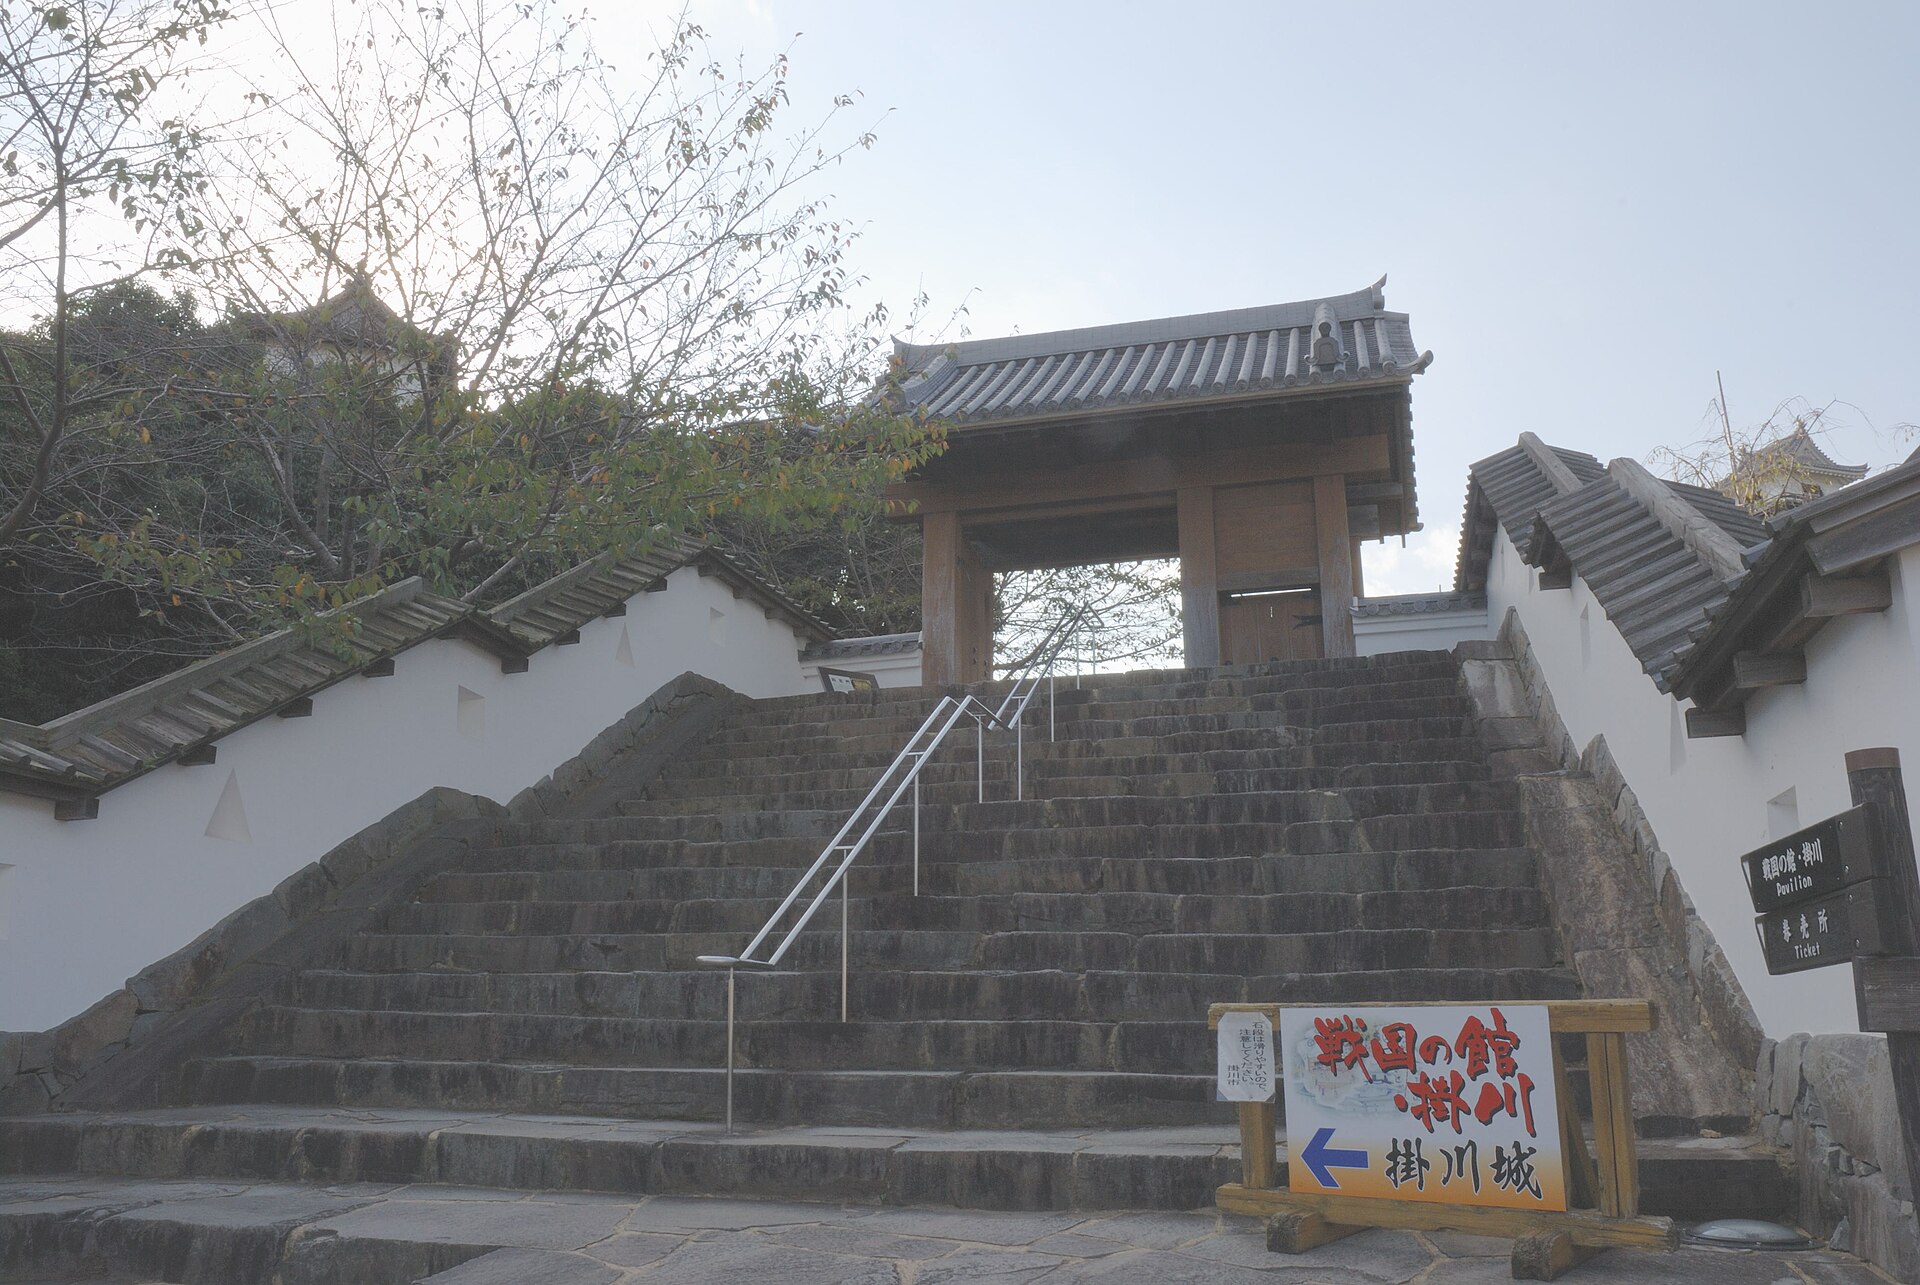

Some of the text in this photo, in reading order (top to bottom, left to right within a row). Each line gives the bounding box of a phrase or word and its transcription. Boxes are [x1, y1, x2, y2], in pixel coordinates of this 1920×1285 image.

[1776, 875, 1813, 897] Pavilion
[1794, 942, 1820, 959] Ticket
[1314, 1007, 1521, 1085] 戦国の館
[1227, 1064, 1240, 1086] 掛川市
[1384, 1137, 1543, 1200] 掛川城
